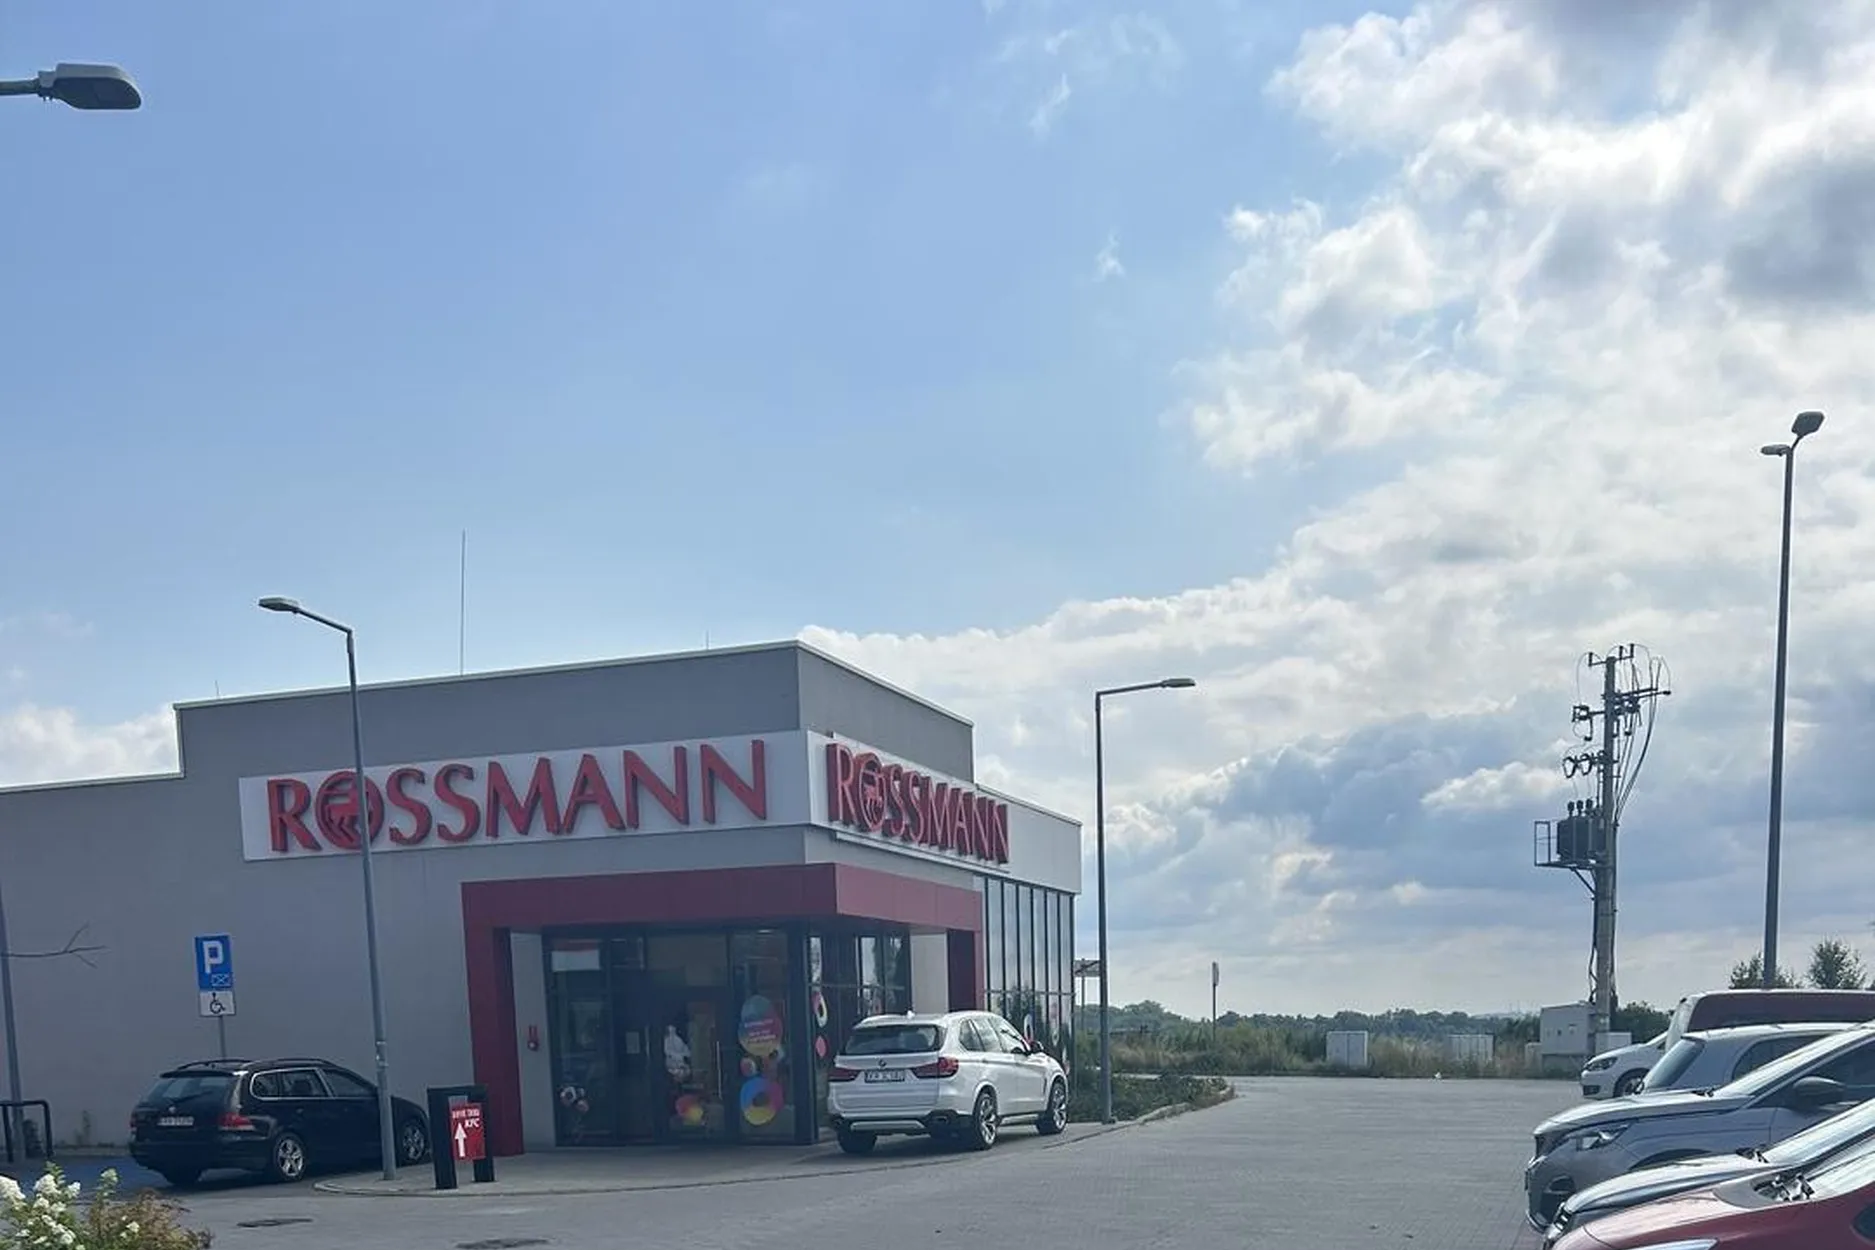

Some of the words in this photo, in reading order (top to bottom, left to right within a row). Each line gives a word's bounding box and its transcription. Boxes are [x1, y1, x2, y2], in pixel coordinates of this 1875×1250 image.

[267, 739, 767, 853] ROSSMANN
[826, 743, 1009, 864] ROSSMANN
[203, 941, 224, 974] P
